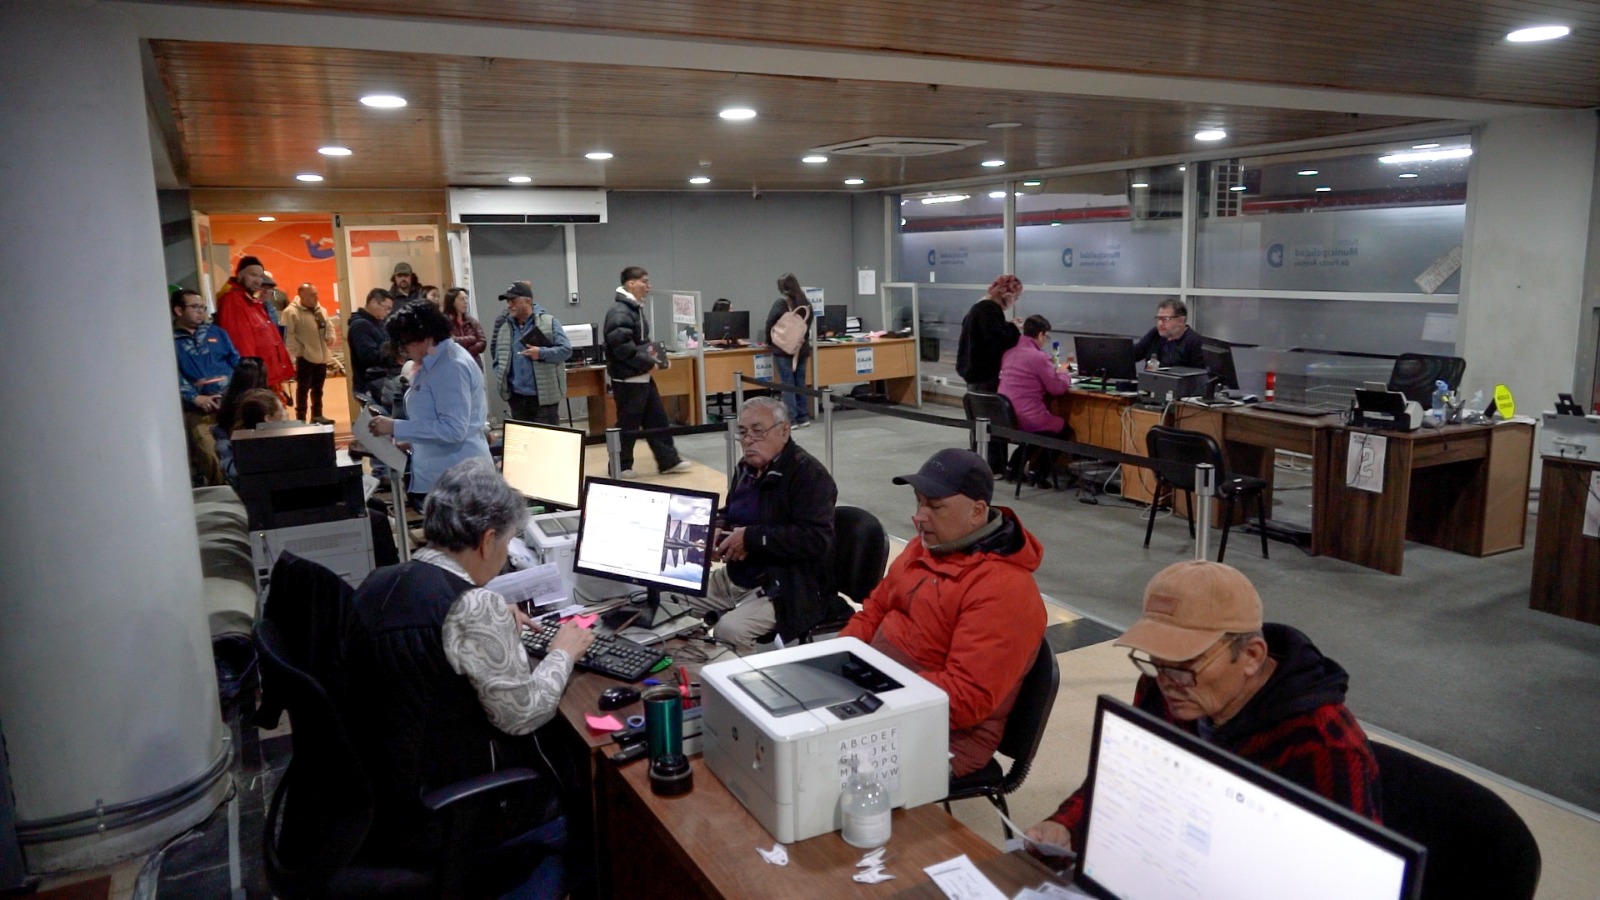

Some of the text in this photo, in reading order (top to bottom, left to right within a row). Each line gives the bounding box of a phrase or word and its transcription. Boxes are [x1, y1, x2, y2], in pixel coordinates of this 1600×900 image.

[1360, 446, 1376, 479] 2
[840, 728, 897, 751] A B C D E F
[840, 755, 848, 765] G
[850, 753, 858, 762] H
[881, 744, 888, 753] K
[891, 742, 897, 750] L
[840, 768, 848, 777] M
[851, 766, 858, 774] N
[881, 757, 888, 767] P
[890, 754, 898, 765] Q
[881, 771, 888, 779] V
[890, 767, 899, 776] W
